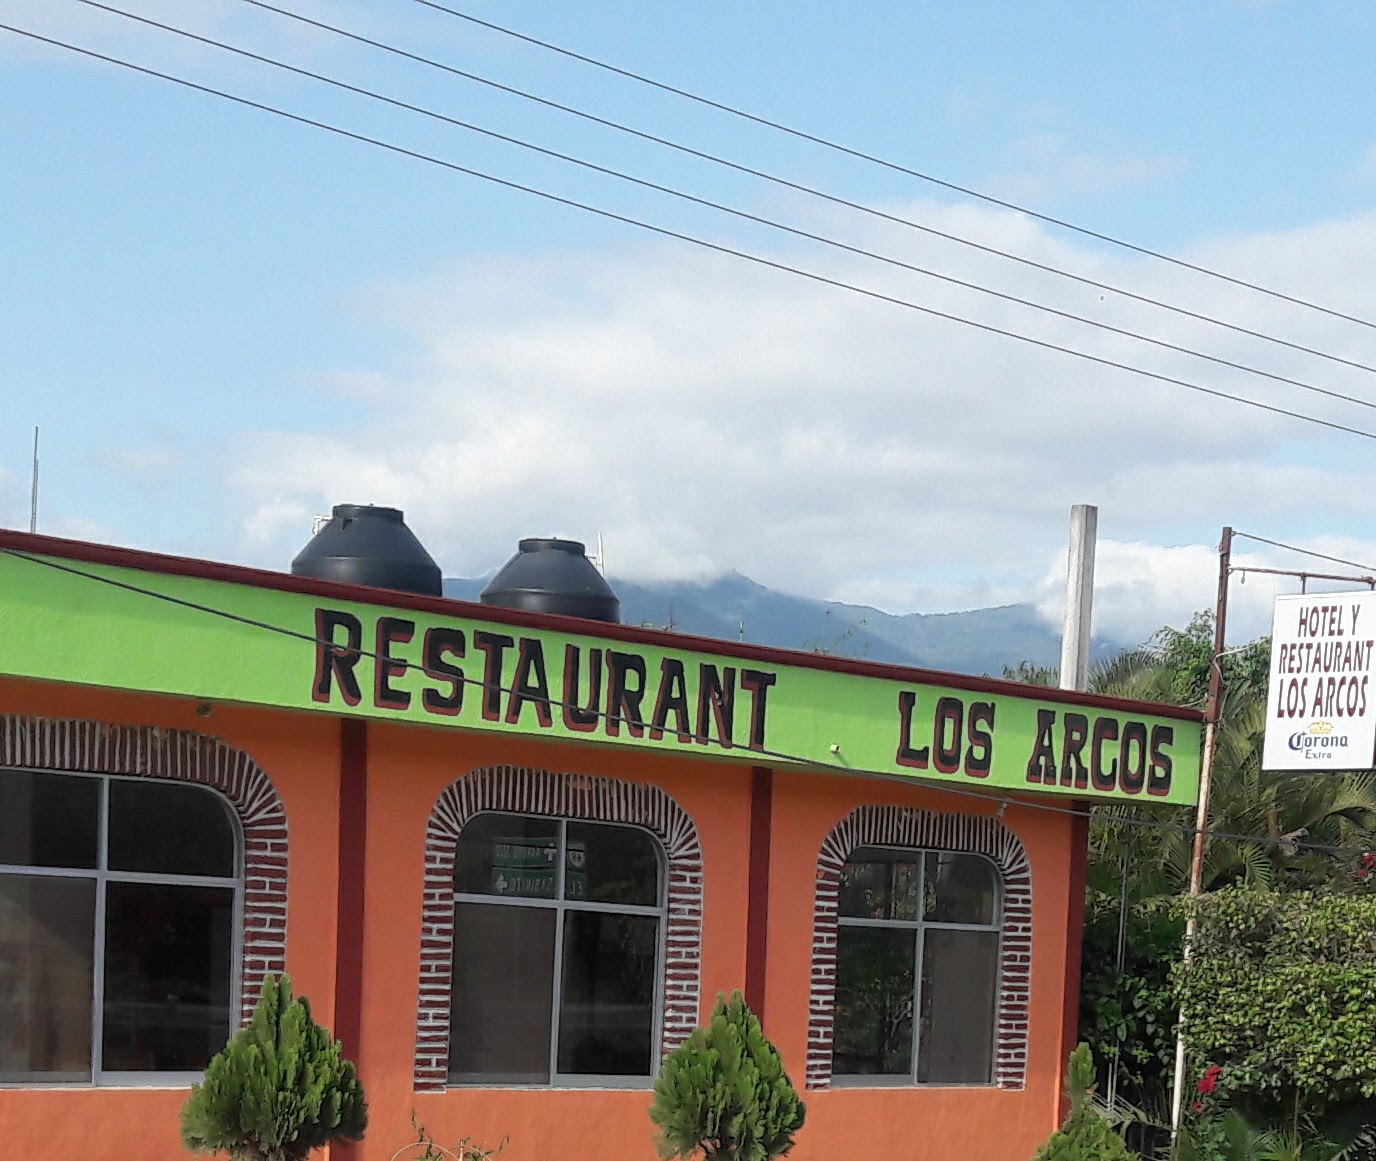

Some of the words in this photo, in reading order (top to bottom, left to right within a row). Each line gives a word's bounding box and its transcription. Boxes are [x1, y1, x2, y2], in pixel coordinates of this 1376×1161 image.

[1297, 604, 1344, 638] HOTEL
[1351, 604, 1361, 636] Y
[1278, 639, 1374, 675] RESTAURANT
[311, 607, 776, 754] RESTAURANT
[895, 689, 995, 779] LOS
[1026, 708, 1175, 798] ARCOS
[1277, 676, 1308, 719] LOS
[1311, 674, 1369, 718] ARCOS
[1288, 730, 1349, 753] Corona
[1304, 748, 1332, 760] Extra
